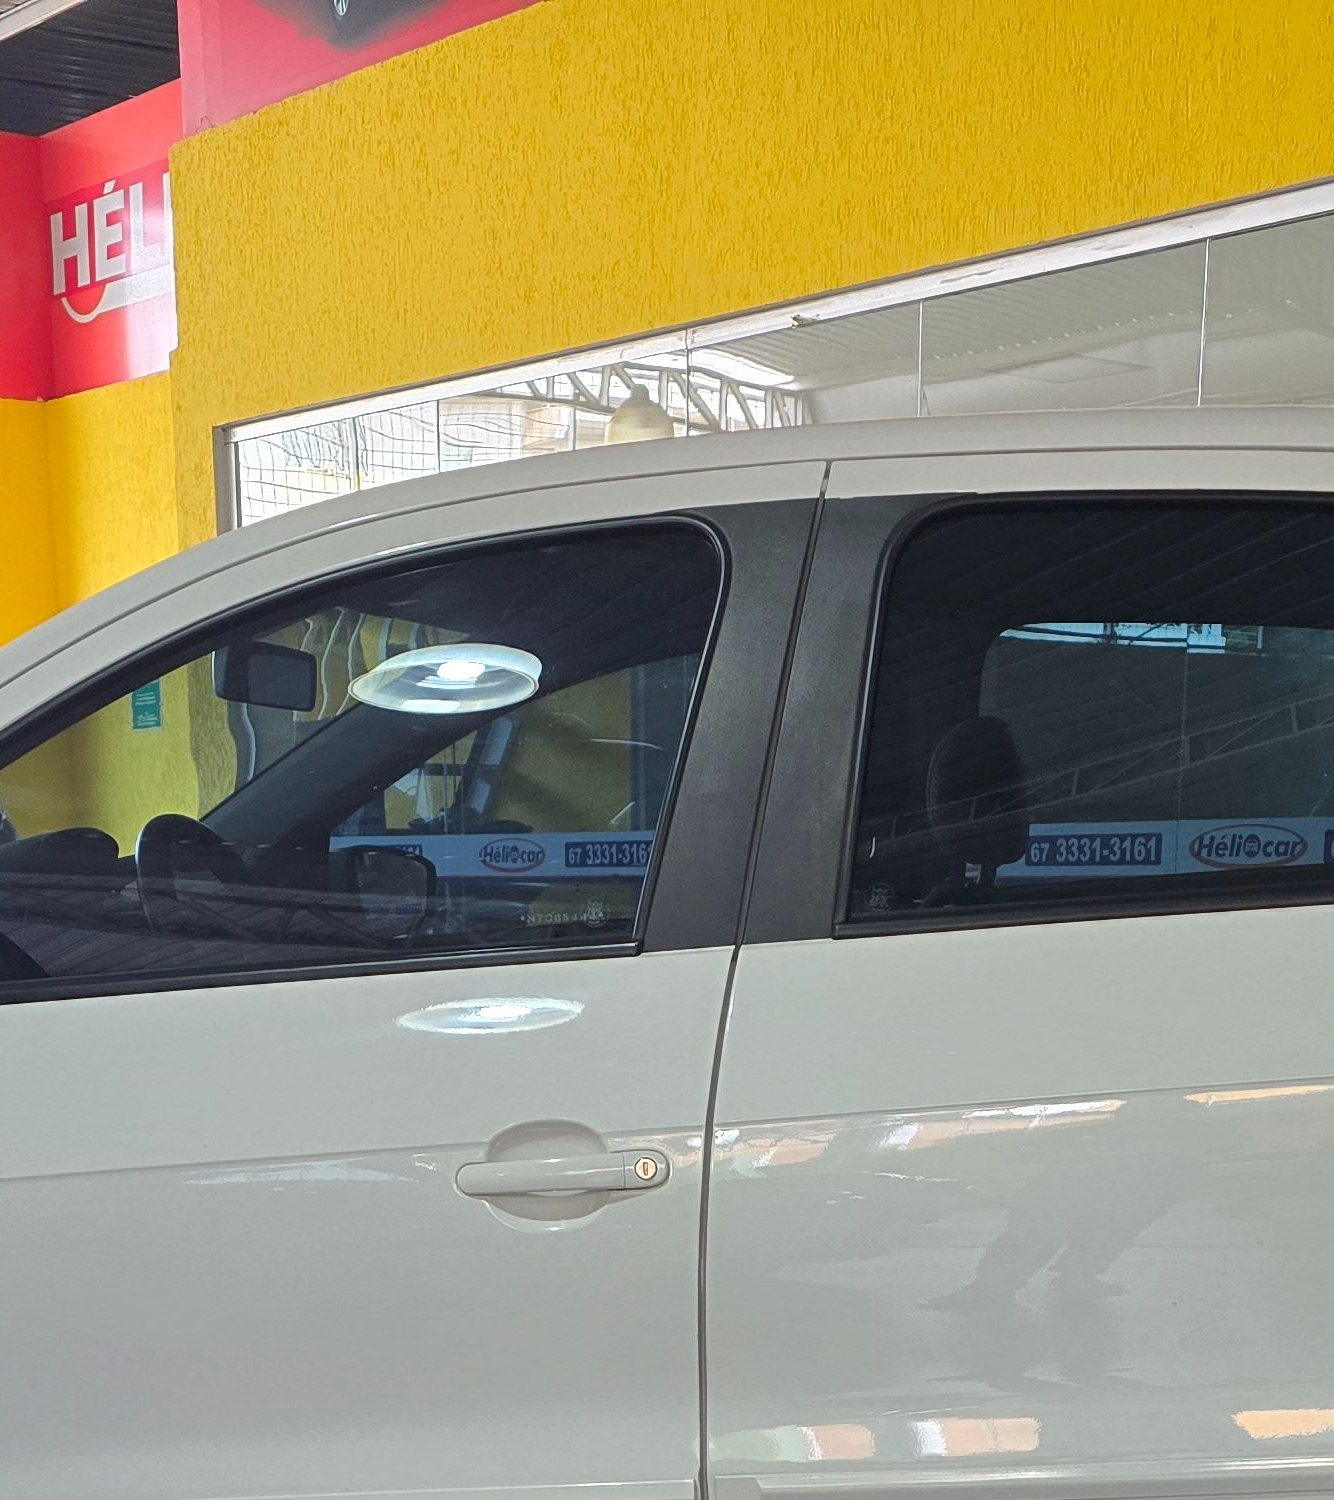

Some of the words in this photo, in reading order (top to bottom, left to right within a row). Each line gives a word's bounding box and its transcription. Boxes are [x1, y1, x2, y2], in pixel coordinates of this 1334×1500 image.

[568, 847, 581, 864] 67
[1030, 842, 1050, 863] 67
[1055, 836, 1156, 862] 3331-3161
